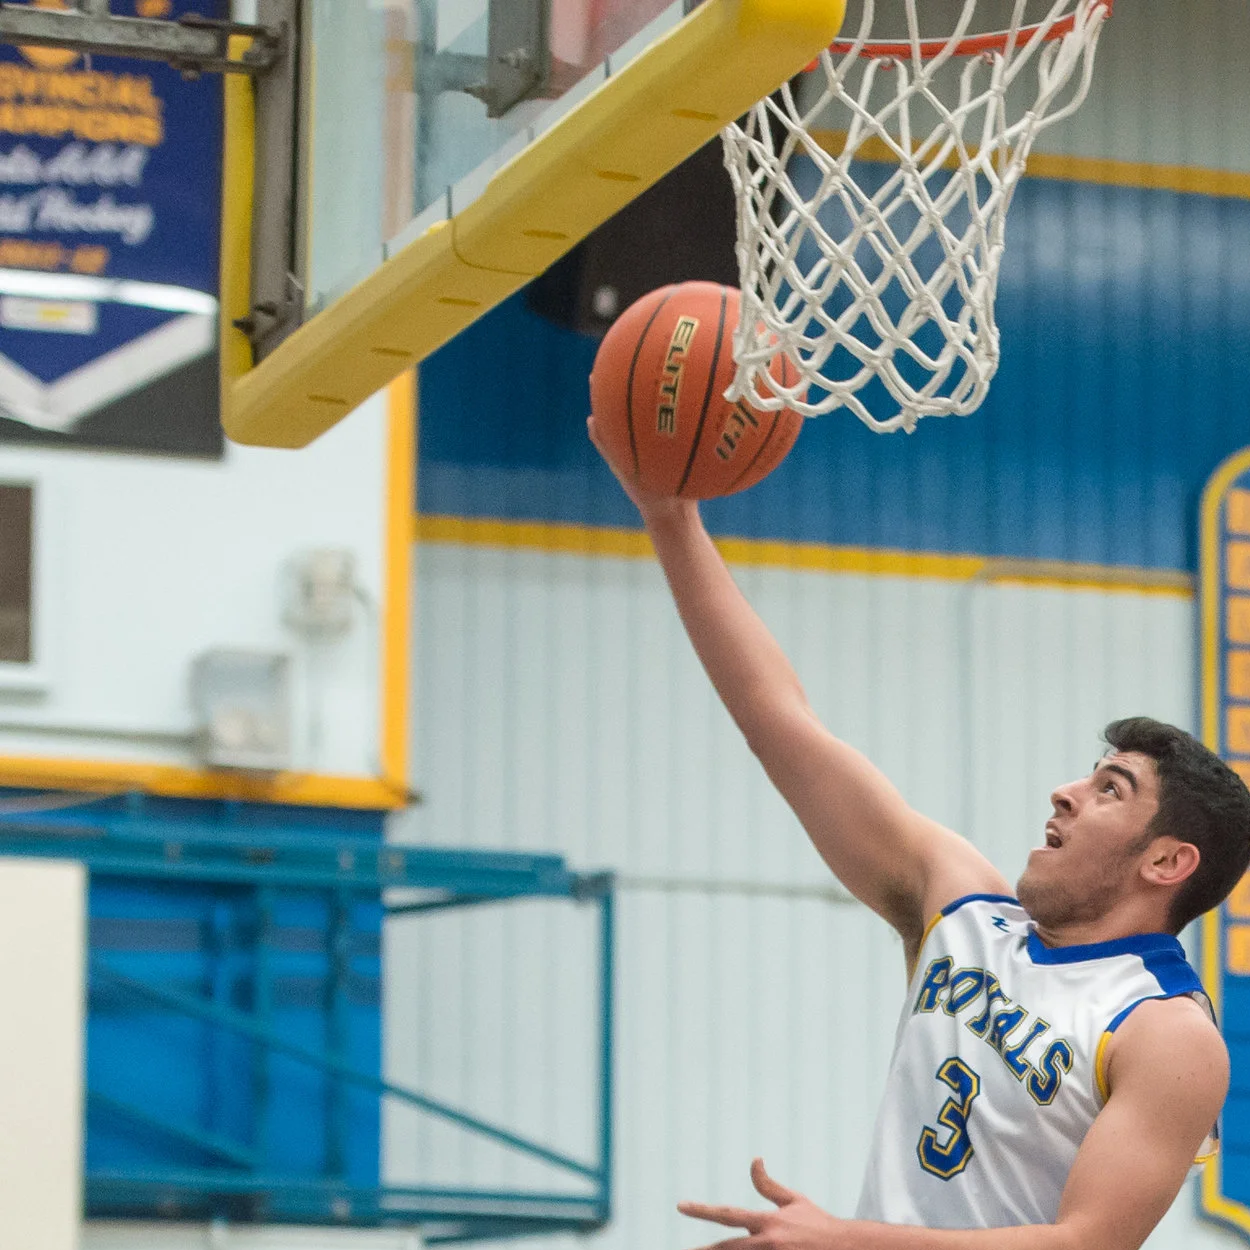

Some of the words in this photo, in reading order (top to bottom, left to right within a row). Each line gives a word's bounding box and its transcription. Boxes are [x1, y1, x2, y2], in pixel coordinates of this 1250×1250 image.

[656, 316, 698, 434] ELITE
[913, 955, 1074, 1107] ROYALS
[916, 1056, 980, 1182] 3
